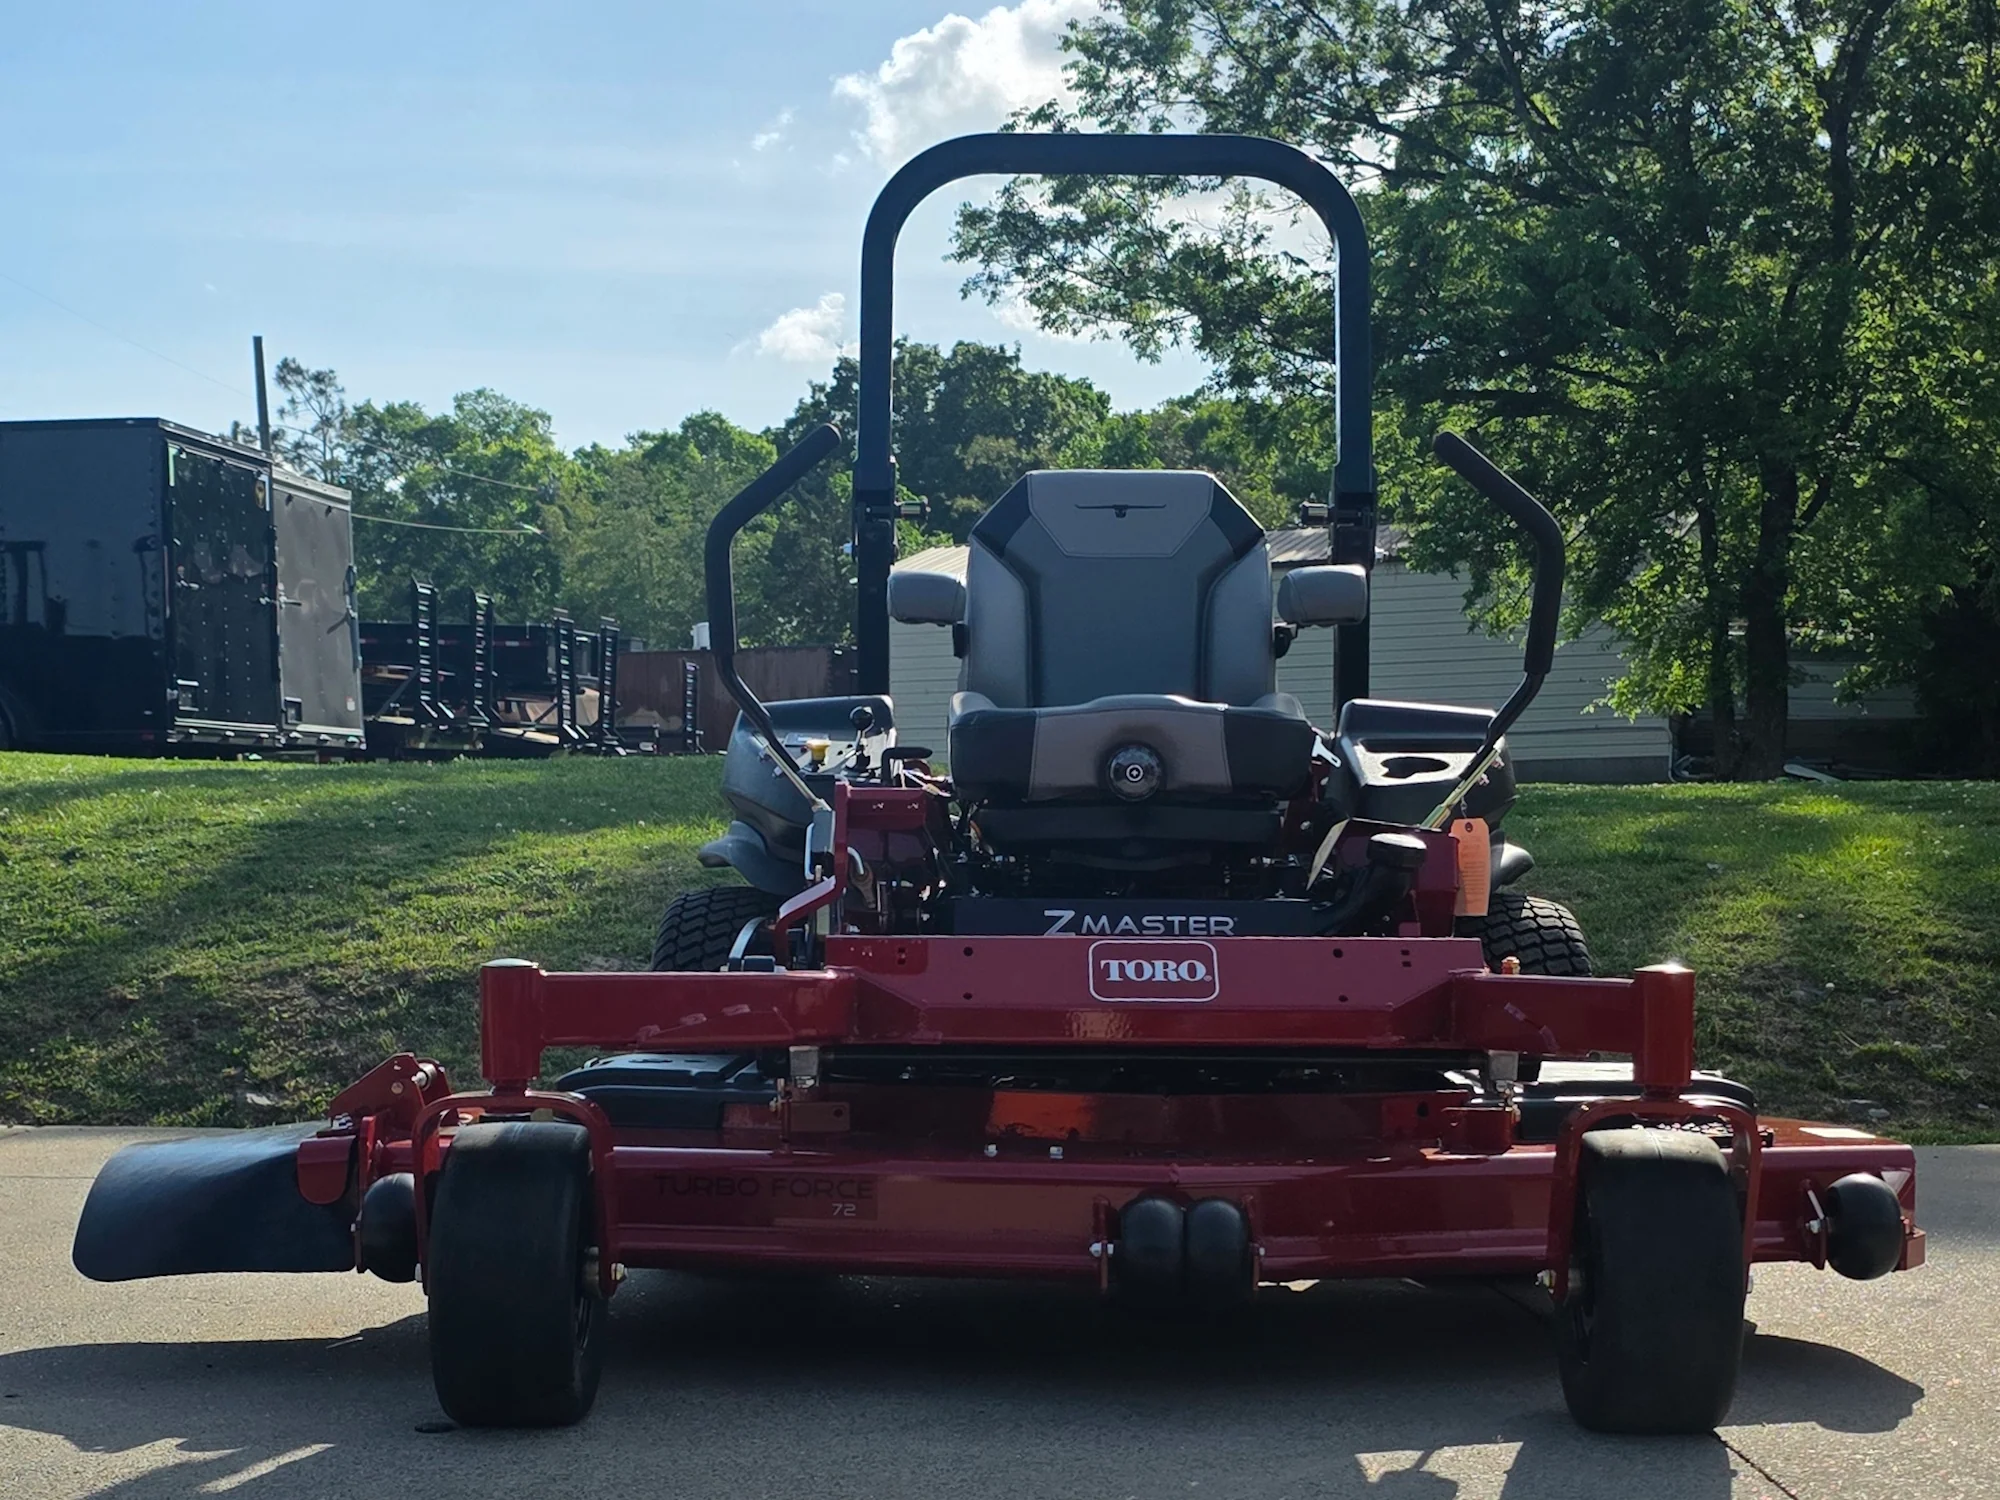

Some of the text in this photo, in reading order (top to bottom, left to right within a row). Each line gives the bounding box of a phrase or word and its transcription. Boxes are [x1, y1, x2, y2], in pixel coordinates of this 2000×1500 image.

[1044, 909, 1236, 936] Z MASTER
[1100, 959, 1208, 982] TORO
[654, 1174, 874, 1200] TURBO FORCE
[831, 1202, 857, 1217] 72
